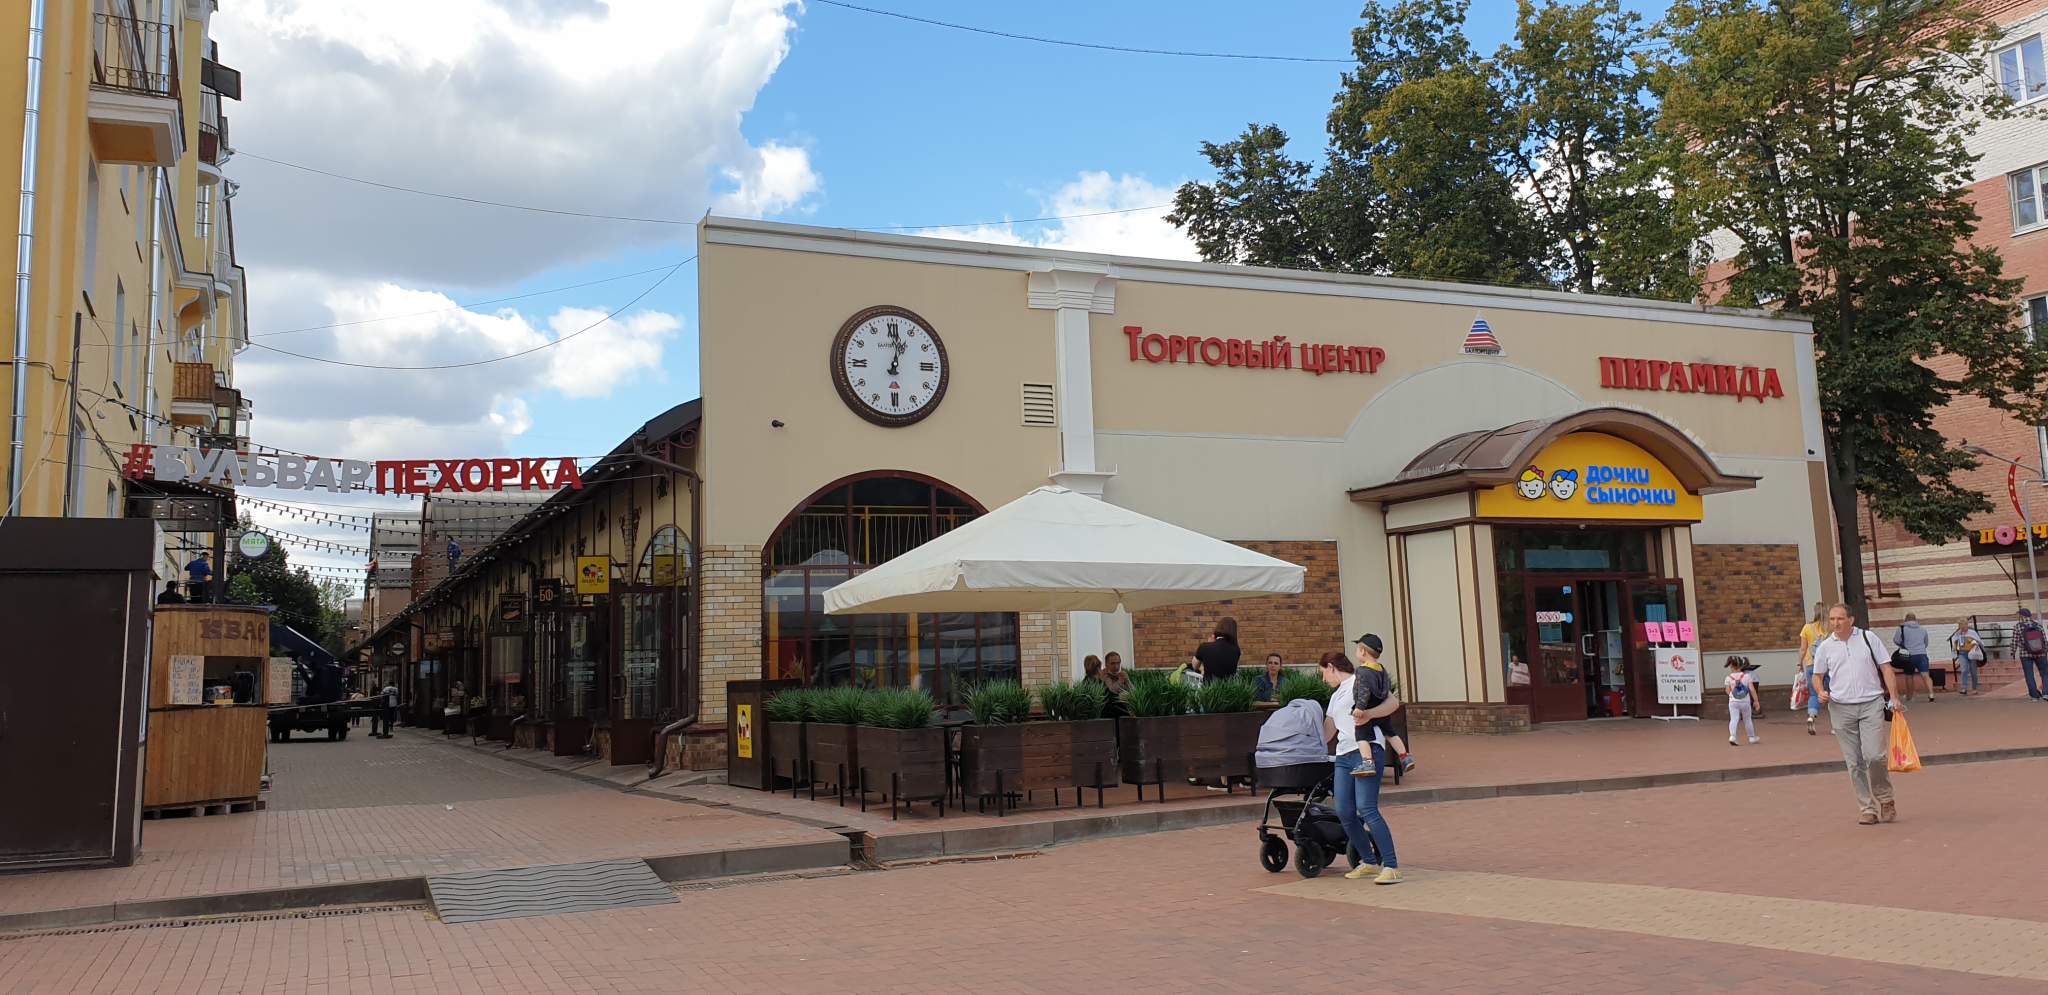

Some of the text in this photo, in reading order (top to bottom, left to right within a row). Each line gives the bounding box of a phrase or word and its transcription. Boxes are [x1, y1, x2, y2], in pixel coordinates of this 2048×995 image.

[1123, 325, 1386, 376] ТОРГОВЫЙ ЦЕНТР
[1599, 356, 1784, 403] ПИРАМИДА
[199, 618, 266, 641] КВАС
